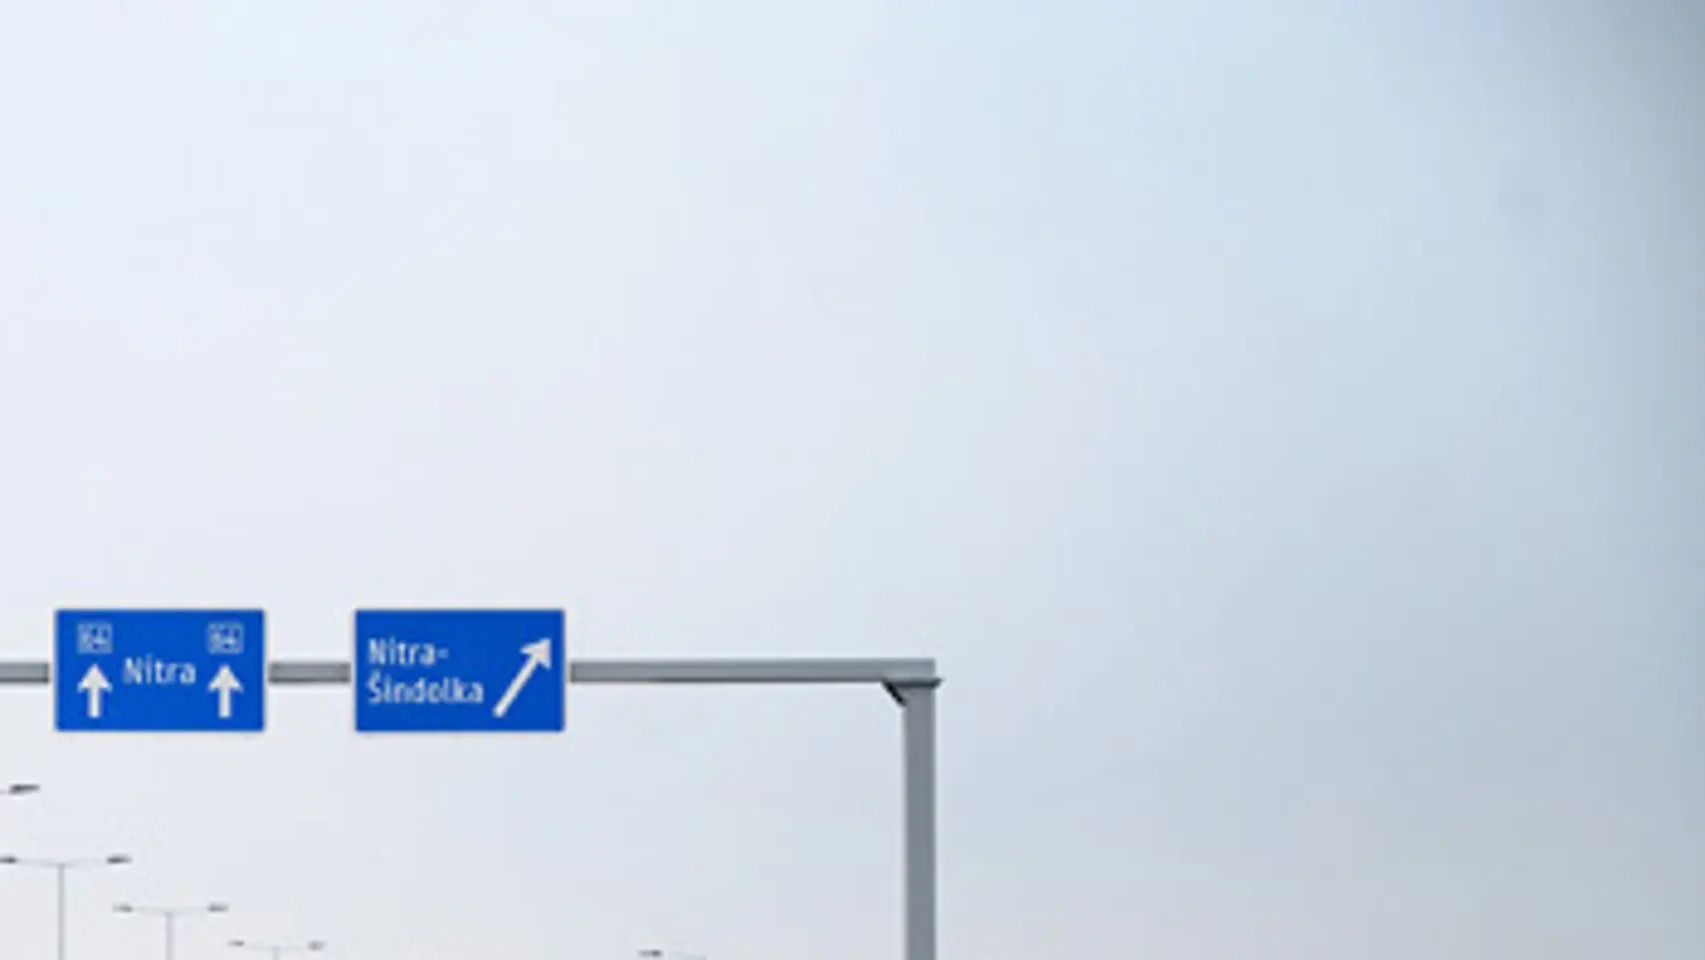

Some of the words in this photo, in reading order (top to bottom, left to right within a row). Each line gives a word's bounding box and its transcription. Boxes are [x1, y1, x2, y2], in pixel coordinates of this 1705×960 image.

[369, 638, 449, 666] Nitra-
[123, 653, 196, 684] Nitra
[367, 669, 484, 703] Šindolka
